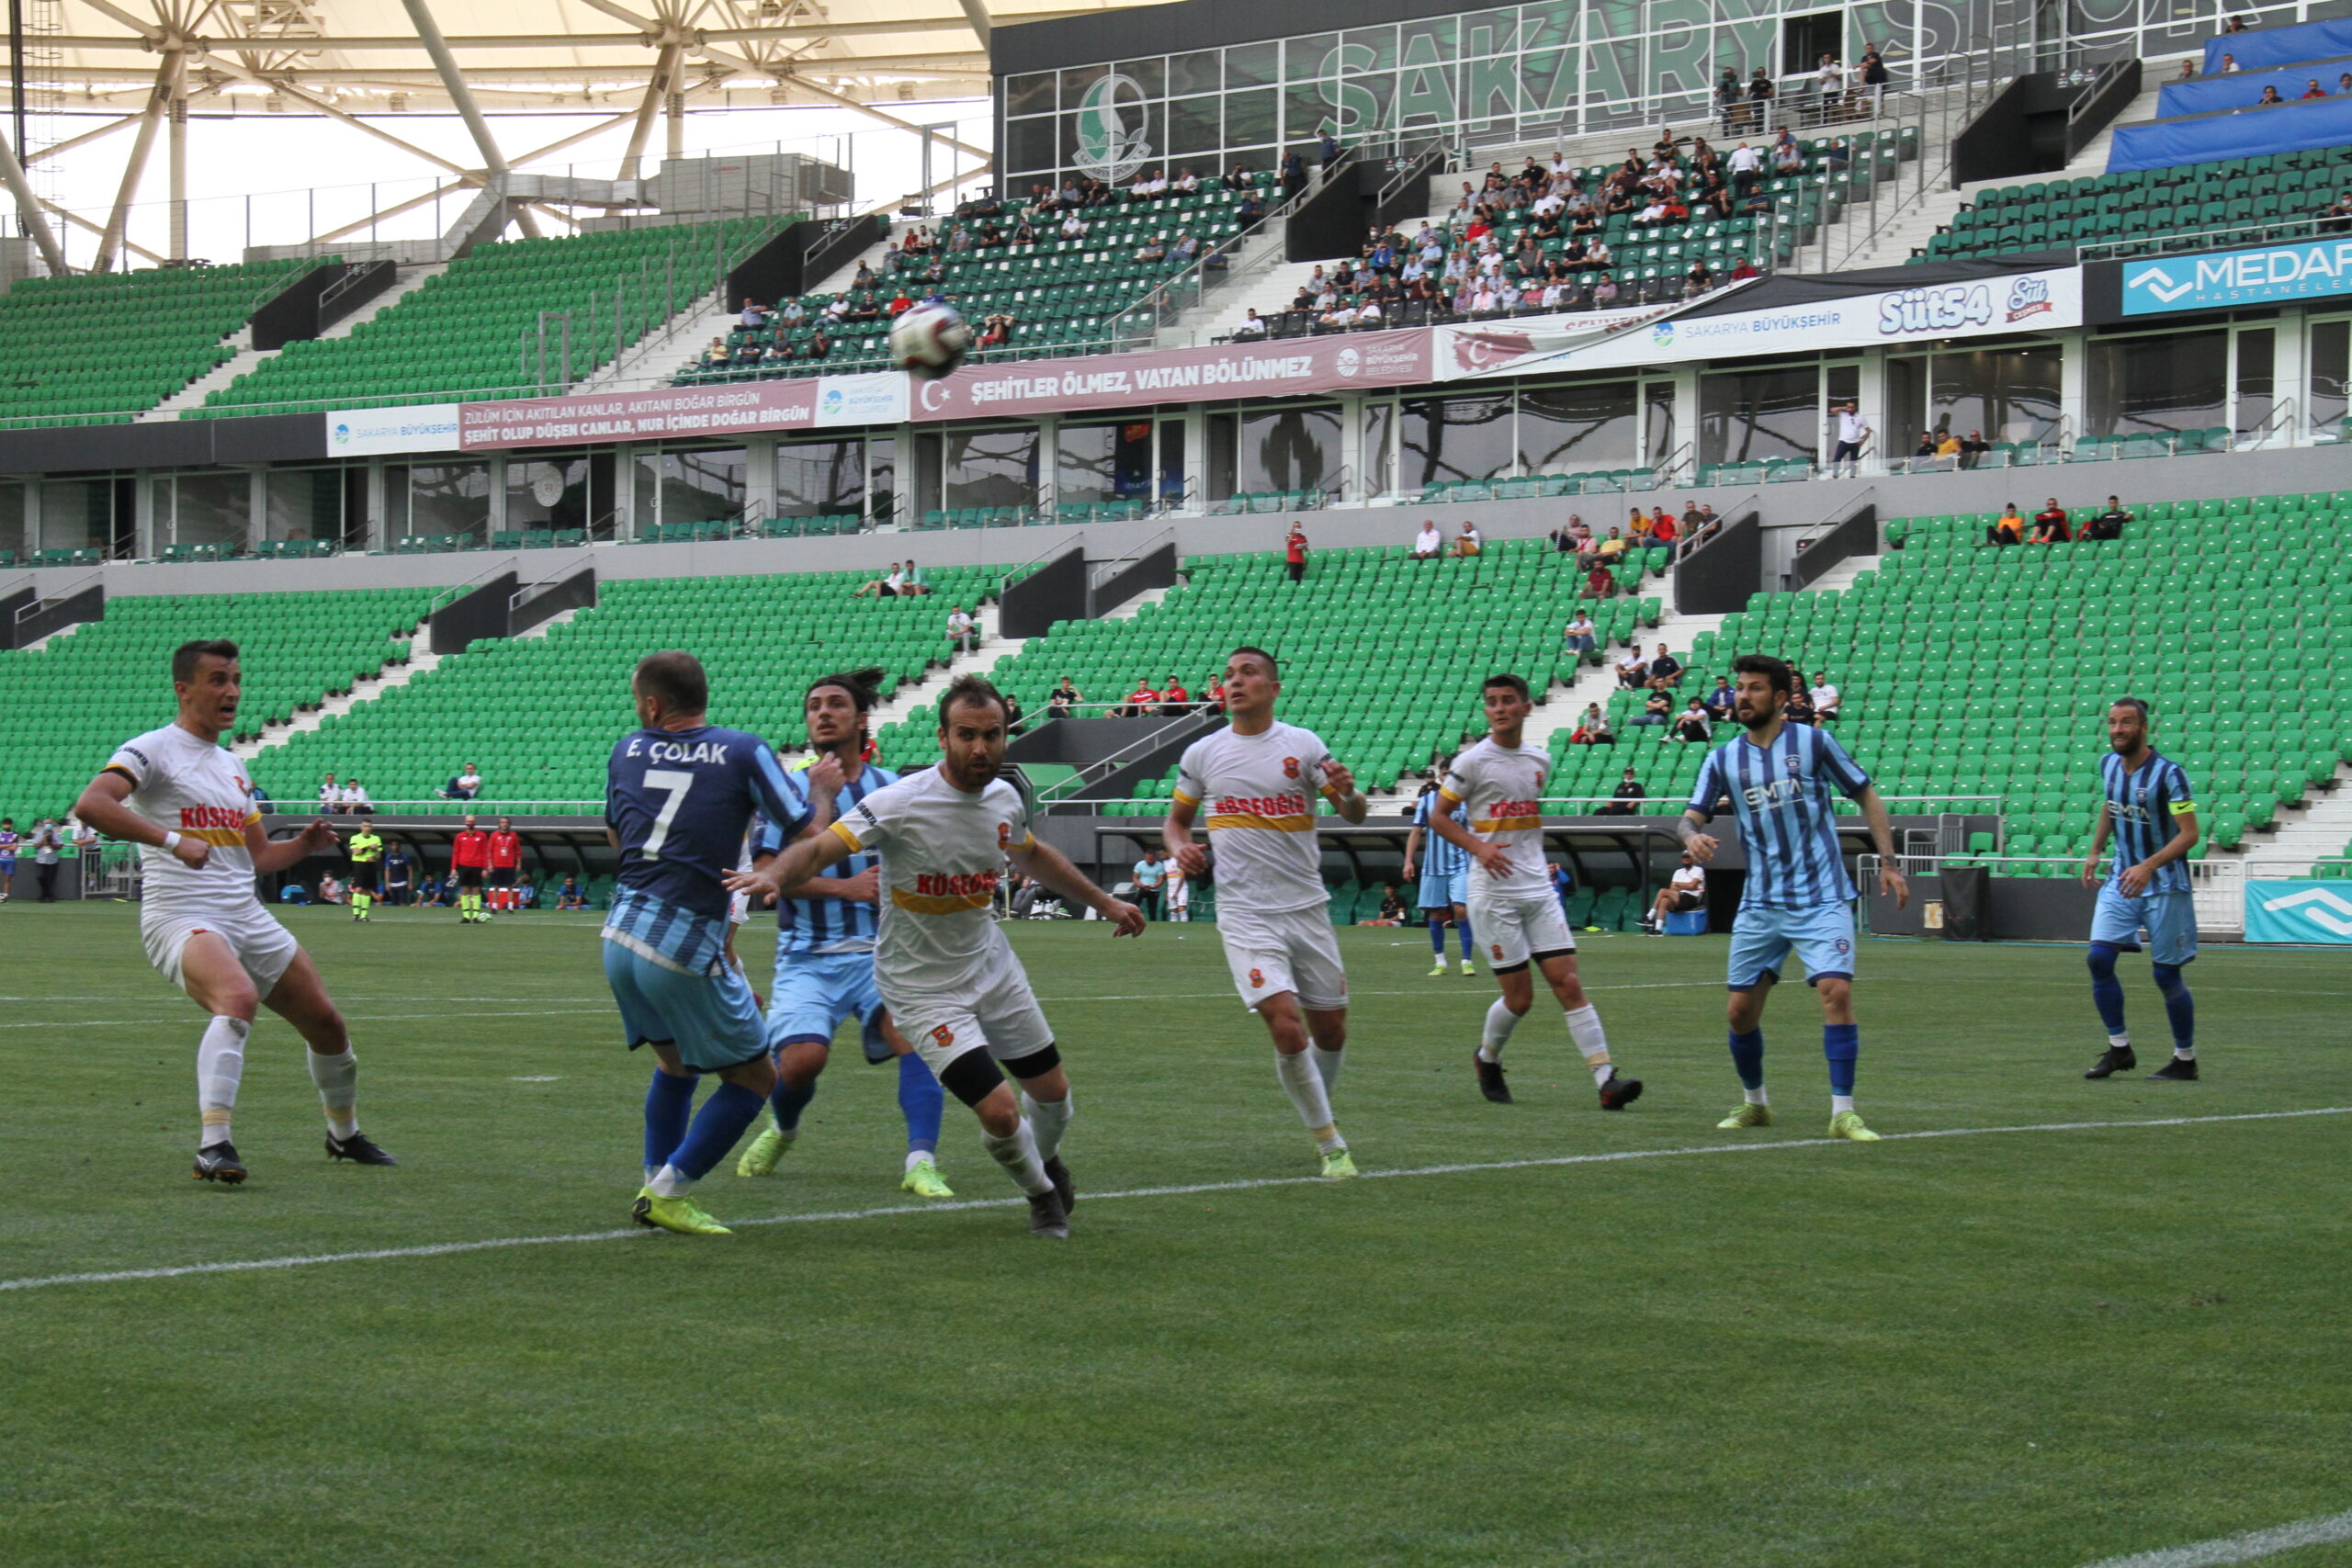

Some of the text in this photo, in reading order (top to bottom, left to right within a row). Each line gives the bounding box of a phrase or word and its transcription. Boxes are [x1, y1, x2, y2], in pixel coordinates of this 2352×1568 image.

[1314, 0, 2262, 147] SAKARYSP
[2196, 279, 2352, 301] HASTANELE
[1685, 310, 1841, 338] SAKARYA BÜYÜKŞEHİR
[1880, 285, 1992, 334] Süt54
[970, 356, 1313, 405] ŞEHİTLER ÖLMEZ, VATAN BÖLÜNMEZ
[465, 405, 809, 445] ŞEHİT OLUP DÜŞEN CANLAR, NUR İÇİNDE DOĞAR BİRGÜN
[502, 407, 524, 423] İÇİN
[526, 405, 577, 421] AKITILAN
[578, 402, 626, 418] KANLAR,
[674, 394, 715, 411] BOĞAR
[626, 739, 728, 764] E. ÇOLAK
[1743, 778, 1802, 806] EMTA
[642, 769, 695, 861] 7
